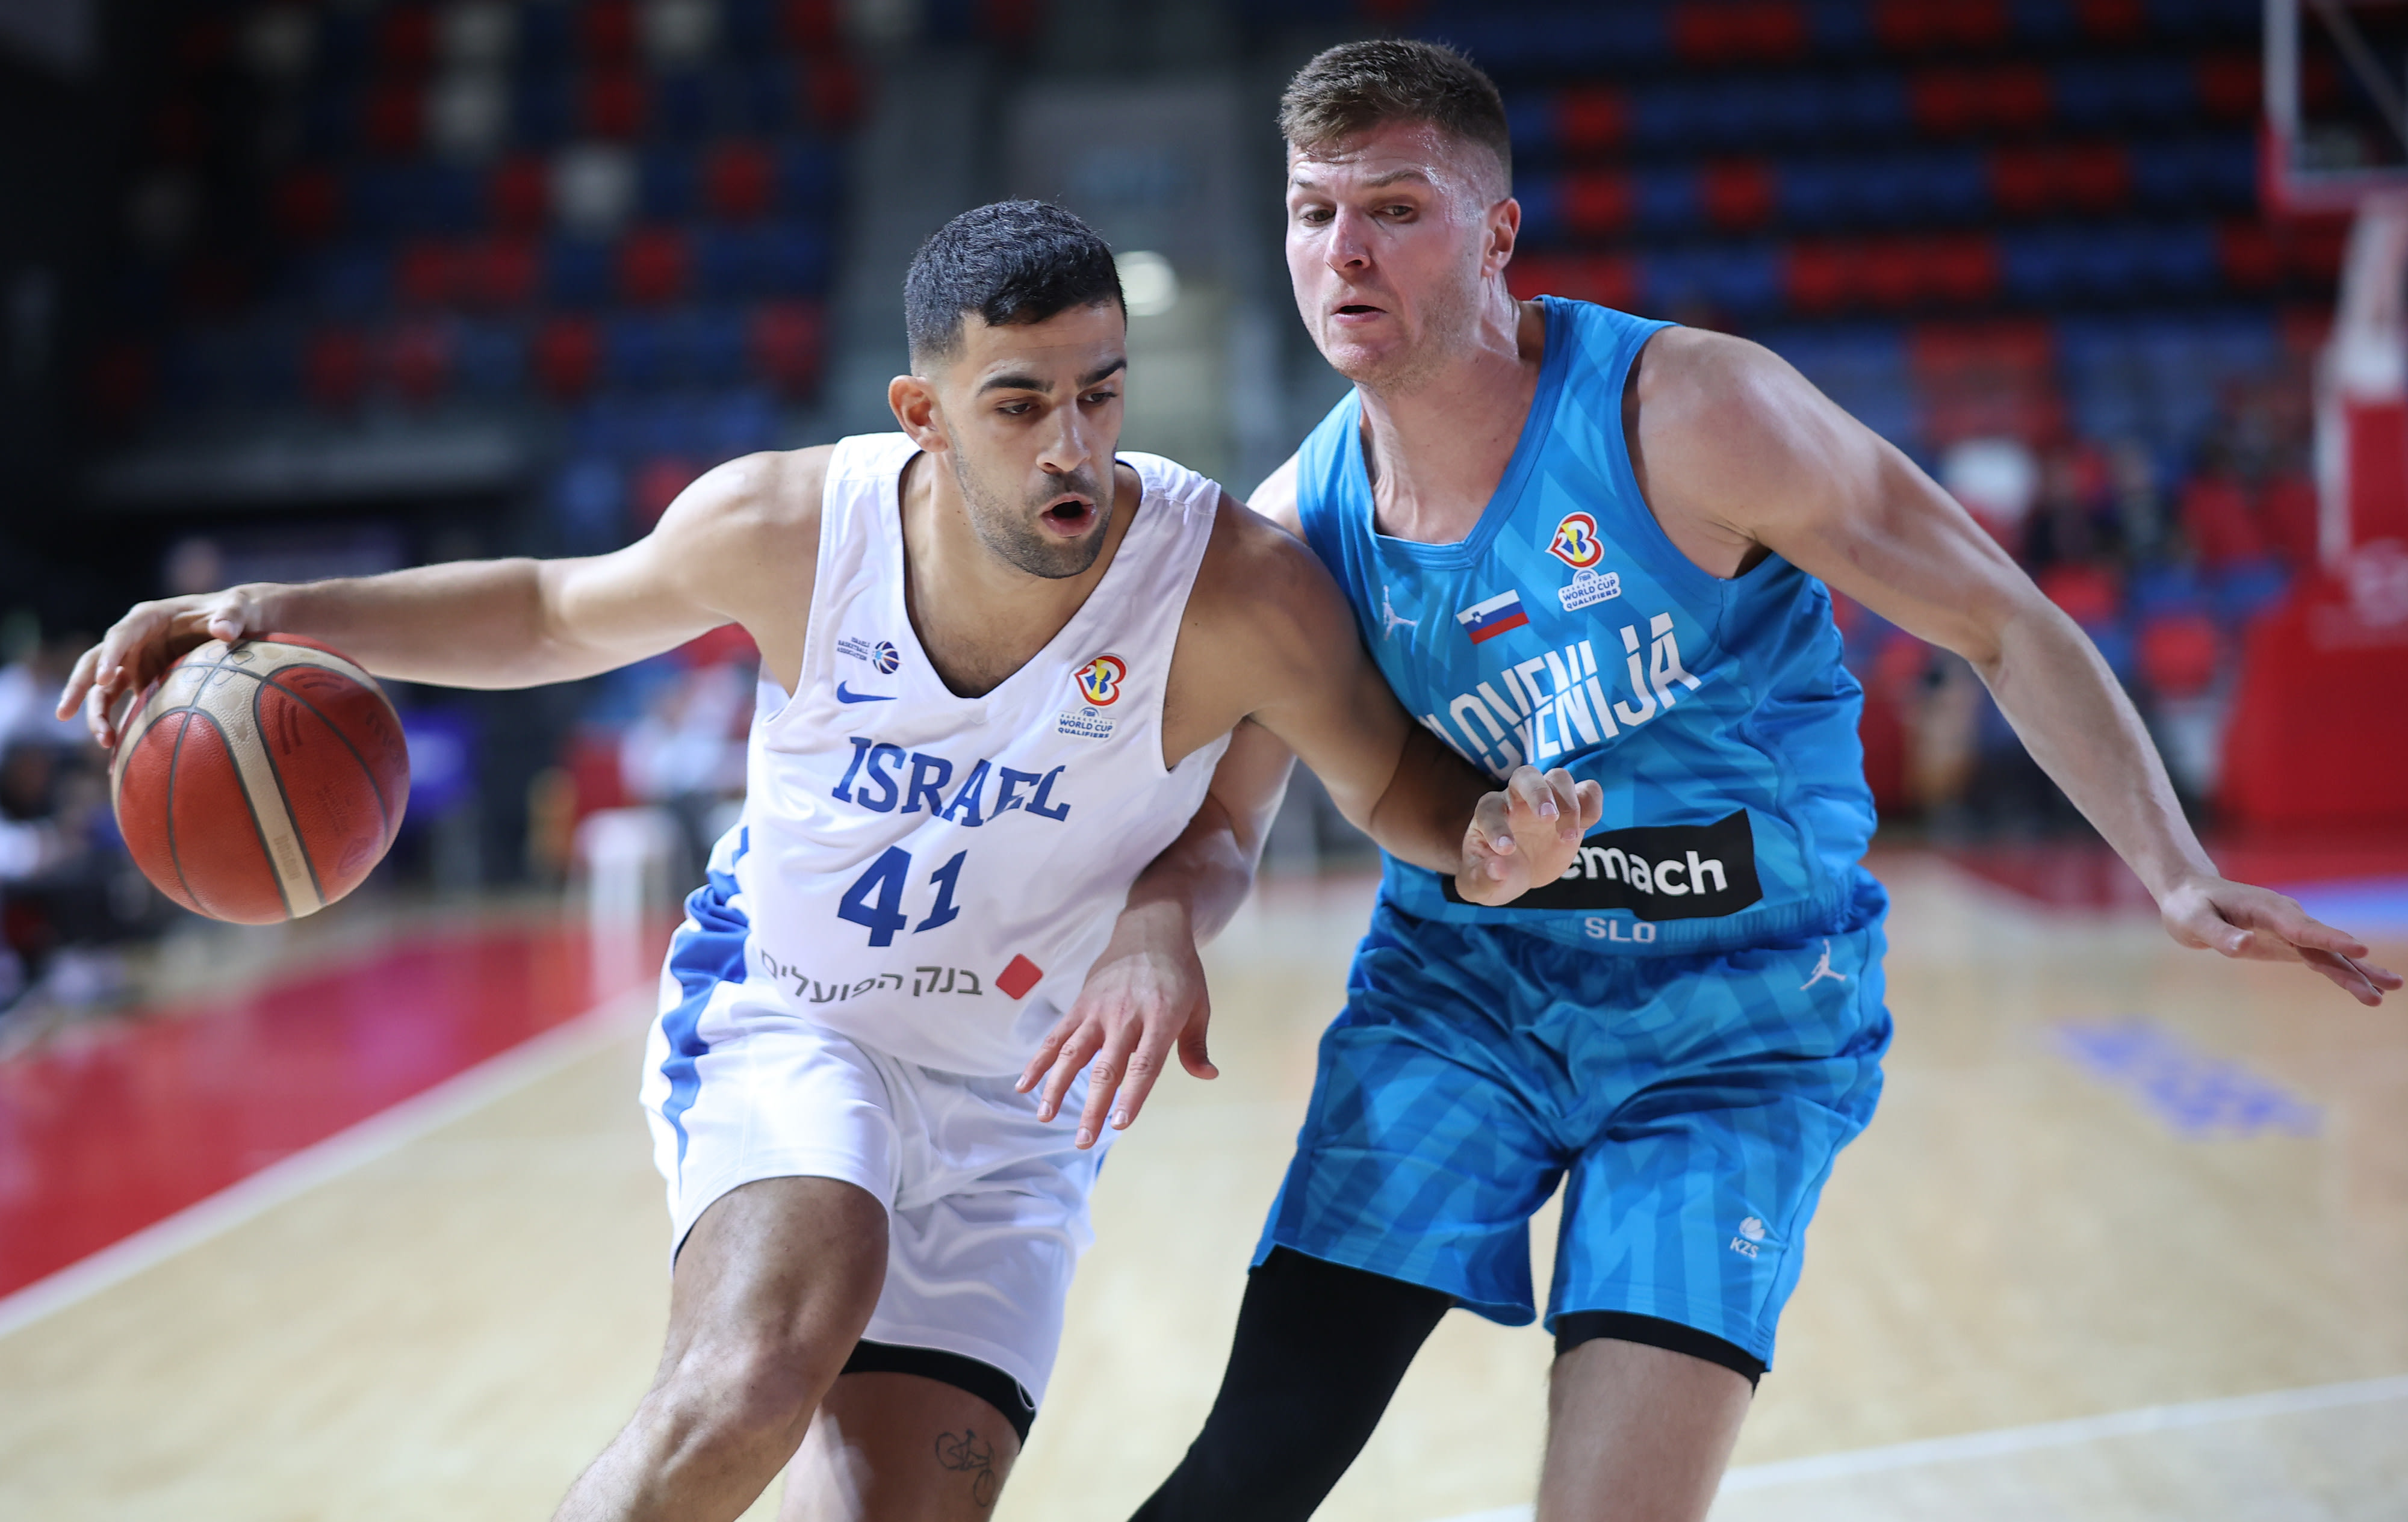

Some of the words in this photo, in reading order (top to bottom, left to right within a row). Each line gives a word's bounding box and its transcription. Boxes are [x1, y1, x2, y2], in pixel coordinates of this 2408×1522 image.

[1563, 586, 1595, 601] WORLD
[1597, 579, 1616, 590] CUP
[1566, 588, 1618, 610] QUALIFIERS
[1418, 611, 1702, 781] OVENIJA
[1058, 727, 1110, 738] QUALIFIERS
[1060, 719, 1093, 730] WORLD
[831, 736, 1071, 828] ISRAEL
[837, 846, 967, 947] 41
[1584, 917, 1656, 944] SLO
[761, 948, 904, 1003] הפועלים
[913, 966, 983, 997] בנק
[1730, 1237, 1759, 1258] KZS
